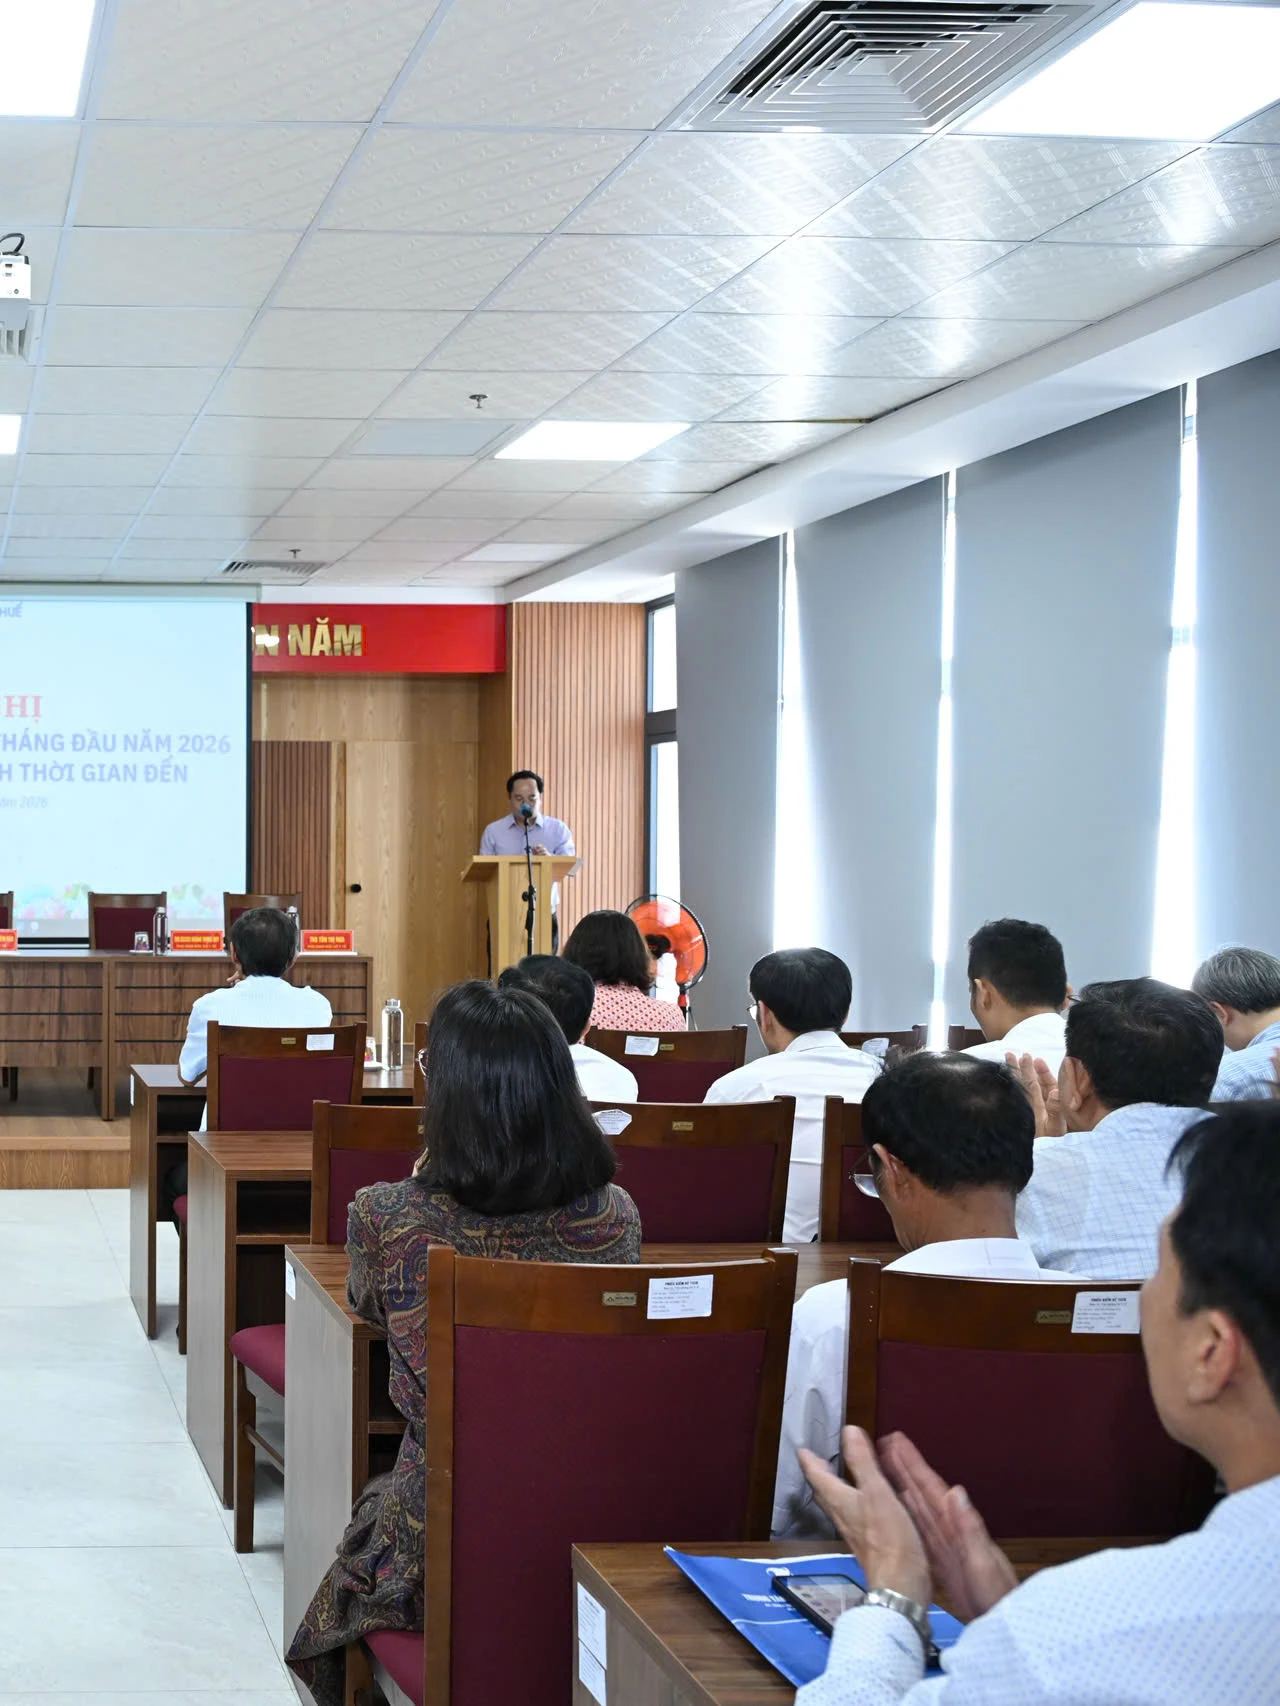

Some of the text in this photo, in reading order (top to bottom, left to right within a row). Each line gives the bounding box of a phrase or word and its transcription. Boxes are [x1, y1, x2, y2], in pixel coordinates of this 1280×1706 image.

[0, 600, 23, 618] HUẾ
[287, 617, 362, 657] NĂM
[70, 728, 117, 753] ĐẦU
[123, 728, 172, 753] NĂM
[177, 734, 232, 754] 2026
[18, 760, 75, 783] THỜI
[81, 763, 137, 783] GIAN
[143, 754, 189, 783] ĐẾN
